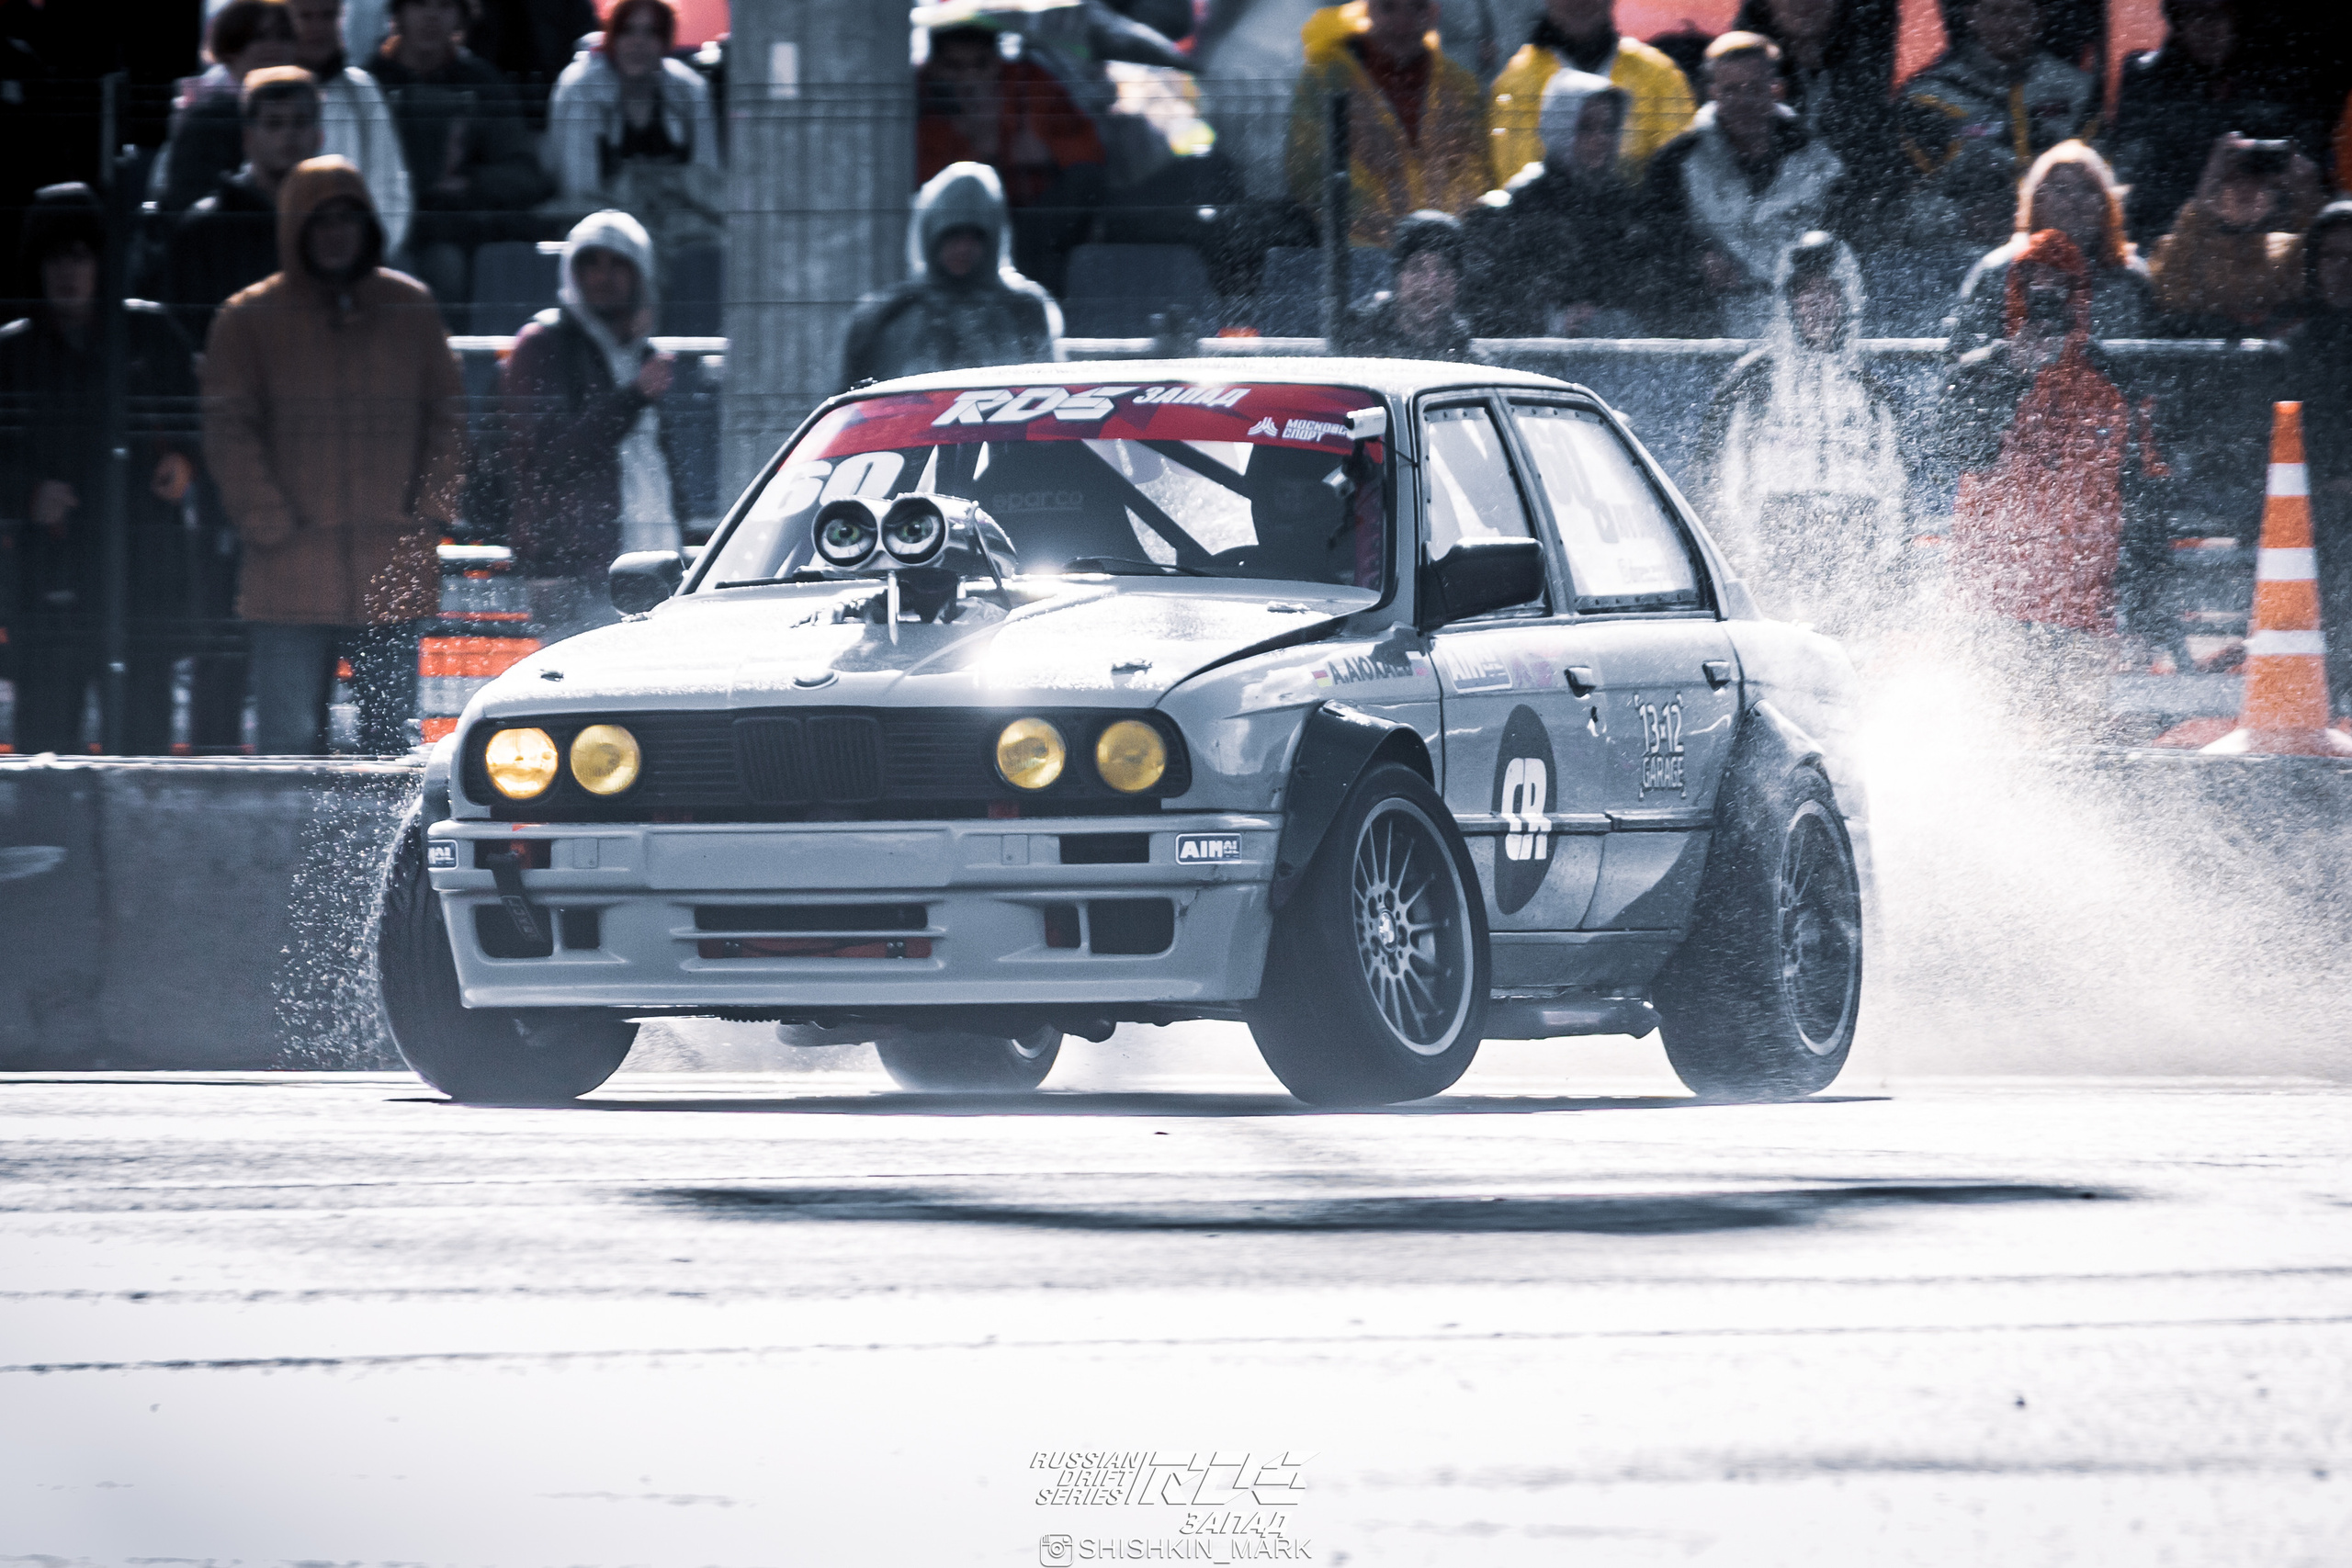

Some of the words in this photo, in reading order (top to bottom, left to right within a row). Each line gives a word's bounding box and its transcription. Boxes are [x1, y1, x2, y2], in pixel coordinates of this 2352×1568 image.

[932, 386, 1140, 427] RDS
[1132, 386, 1251, 408] ЗАПАД
[1282, 428, 1326, 443] СПОРТ
[1285, 418, 1348, 435] МОСКОВС
[748, 451, 905, 522] 60
[1642, 756, 1684, 788] GARAGE
